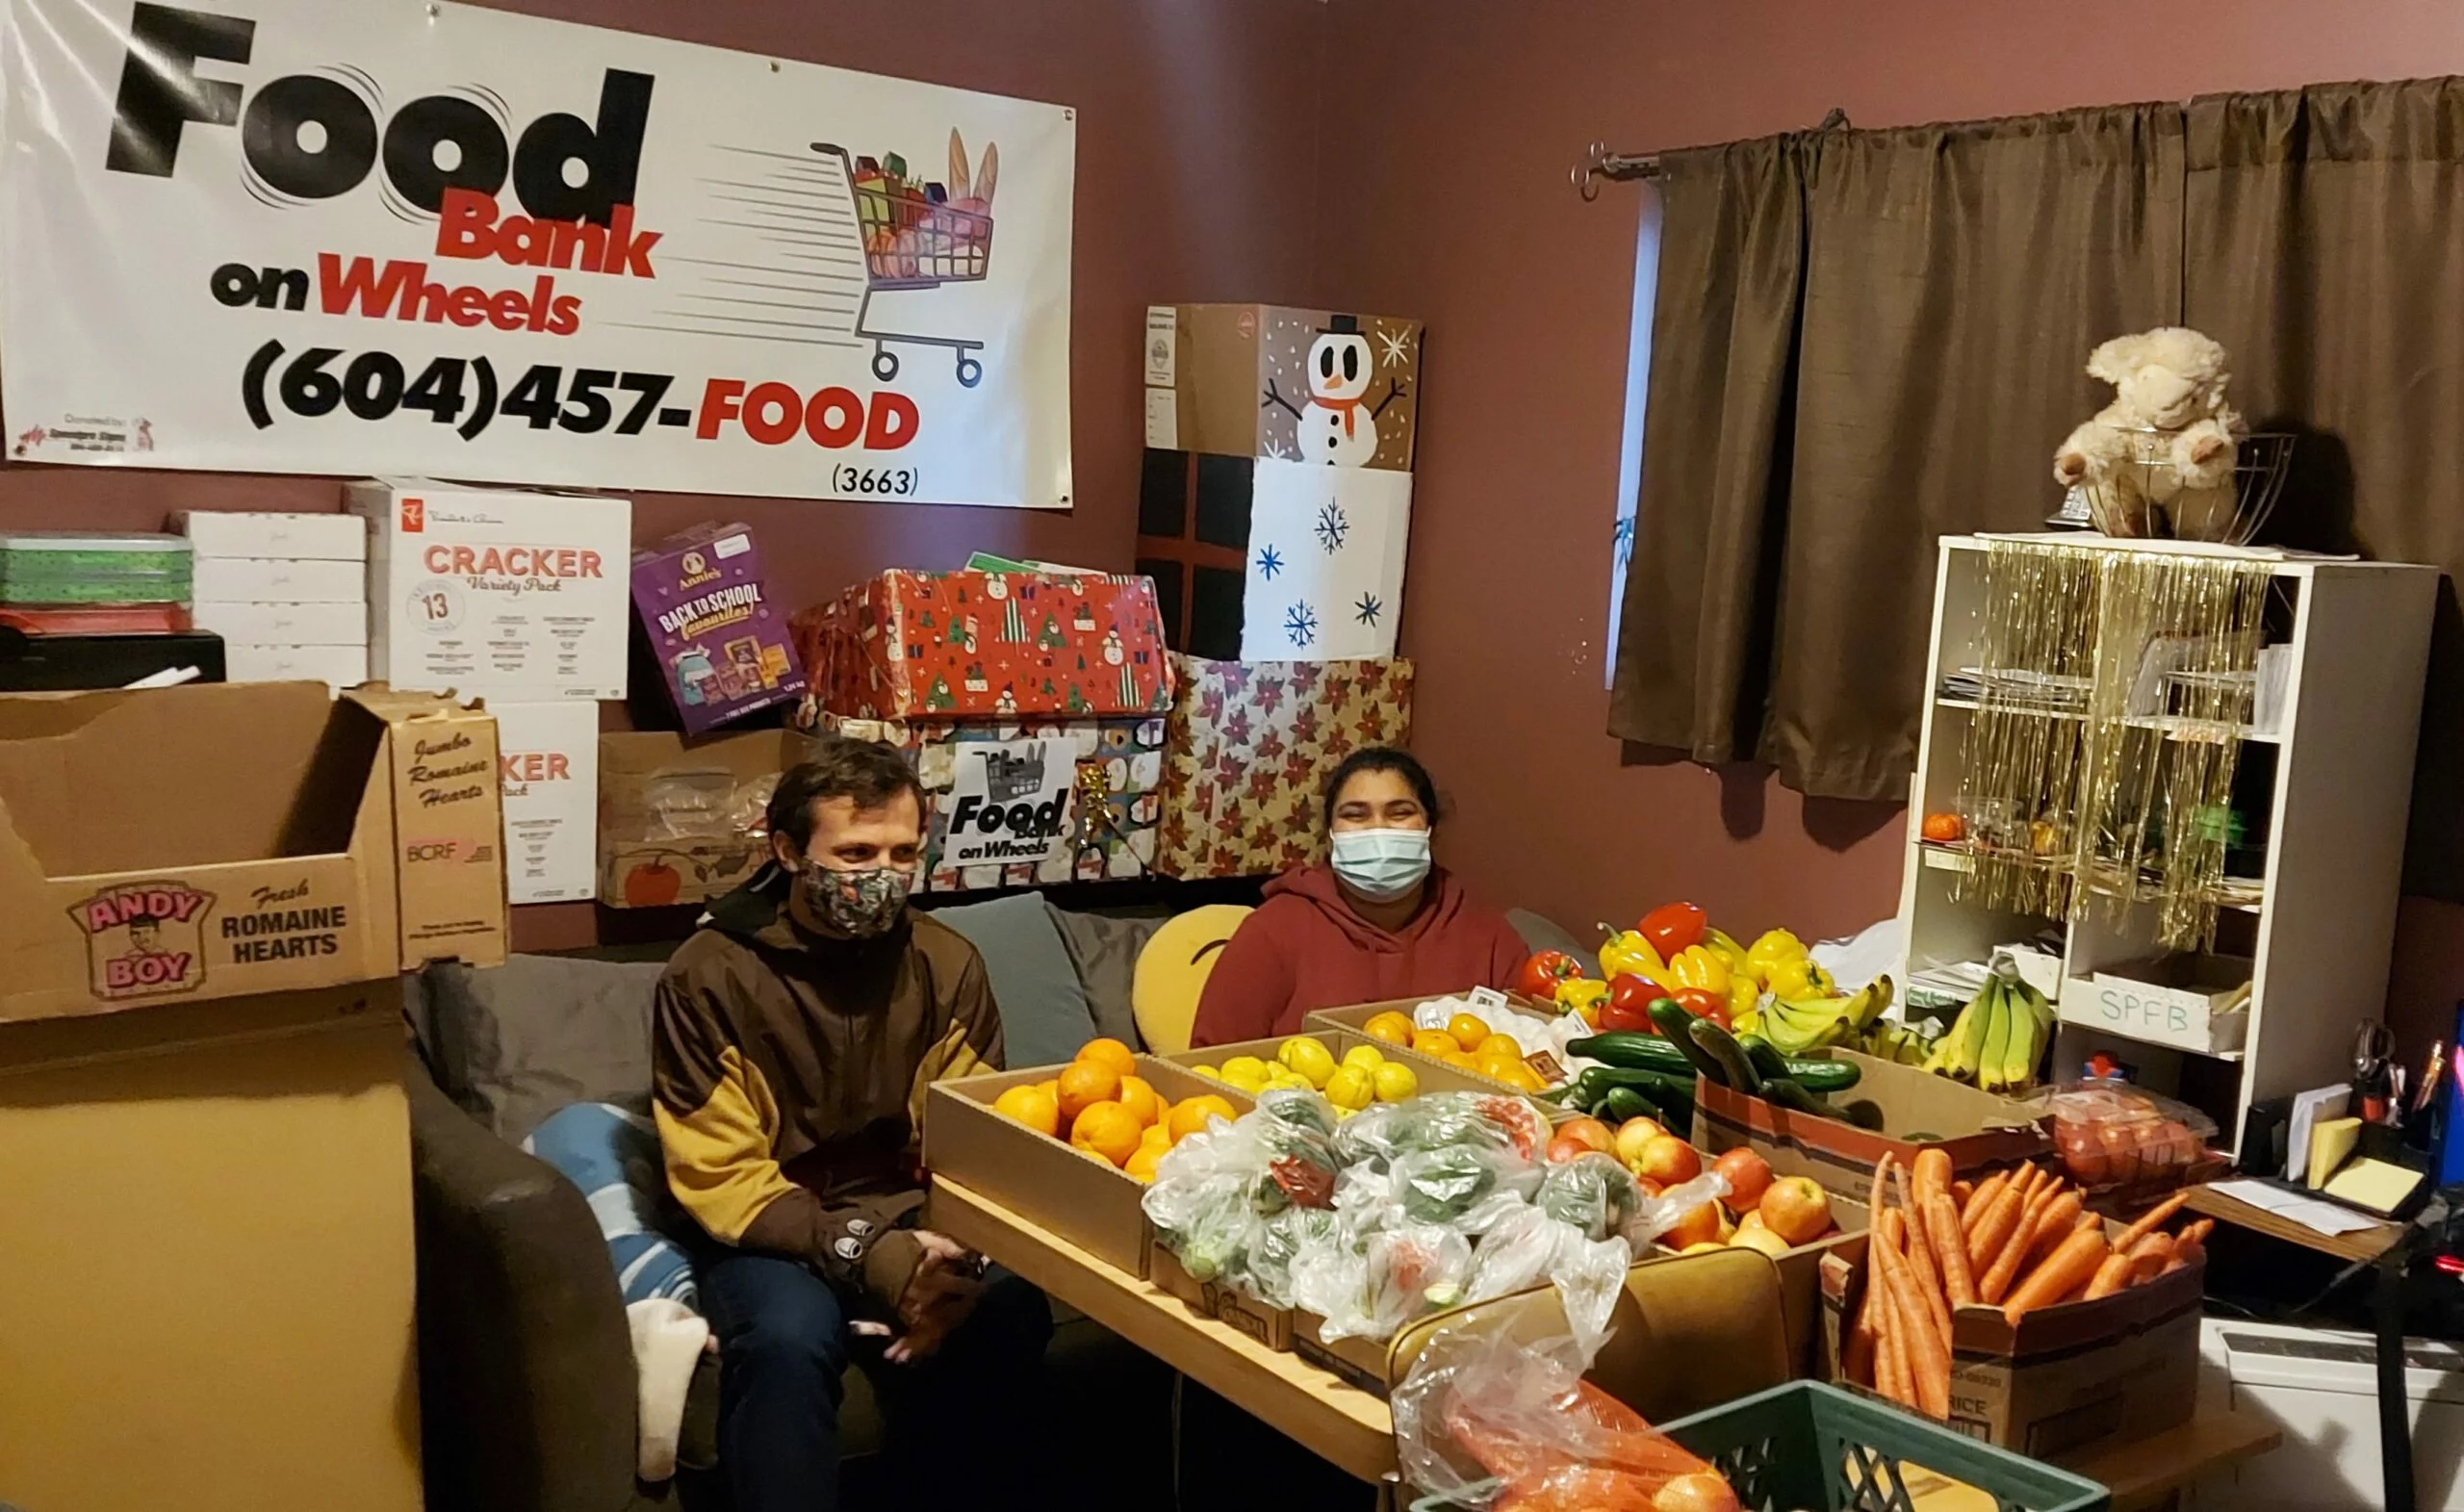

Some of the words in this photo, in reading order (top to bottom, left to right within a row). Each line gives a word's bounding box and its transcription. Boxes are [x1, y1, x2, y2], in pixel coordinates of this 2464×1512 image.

[106, 1, 655, 229] Food
[435, 186, 663, 279] Bank
[210, 263, 309, 311] on
[317, 252, 582, 336] Wheels
[831, 463, 919, 497] (3663)
[424, 544, 603, 578] CRACKER
[467, 577, 521, 596] Variety
[524, 578, 562, 592] Pack
[422, 593, 449, 620] 13
[658, 602, 699, 633] BACK
[693, 598, 711, 616] TO
[707, 583, 762, 612] SCHOOL
[414, 731, 471, 765] Jumbo
[407, 760, 489, 786] Romaine
[419, 784, 483, 808] Hearts
[950, 788, 1069, 834] Food
[408, 842, 457, 862] BCRF
[959, 847, 984, 859] on
[984, 837, 1050, 858] Wheels
[88, 888, 204, 933] ANDY
[250, 878, 309, 910] Fresh
[221, 906, 347, 938] ROMAINE
[233, 934, 338, 963] HEARTS
[106, 952, 192, 988] BOY
[2099, 989, 2189, 1033] SPFB
